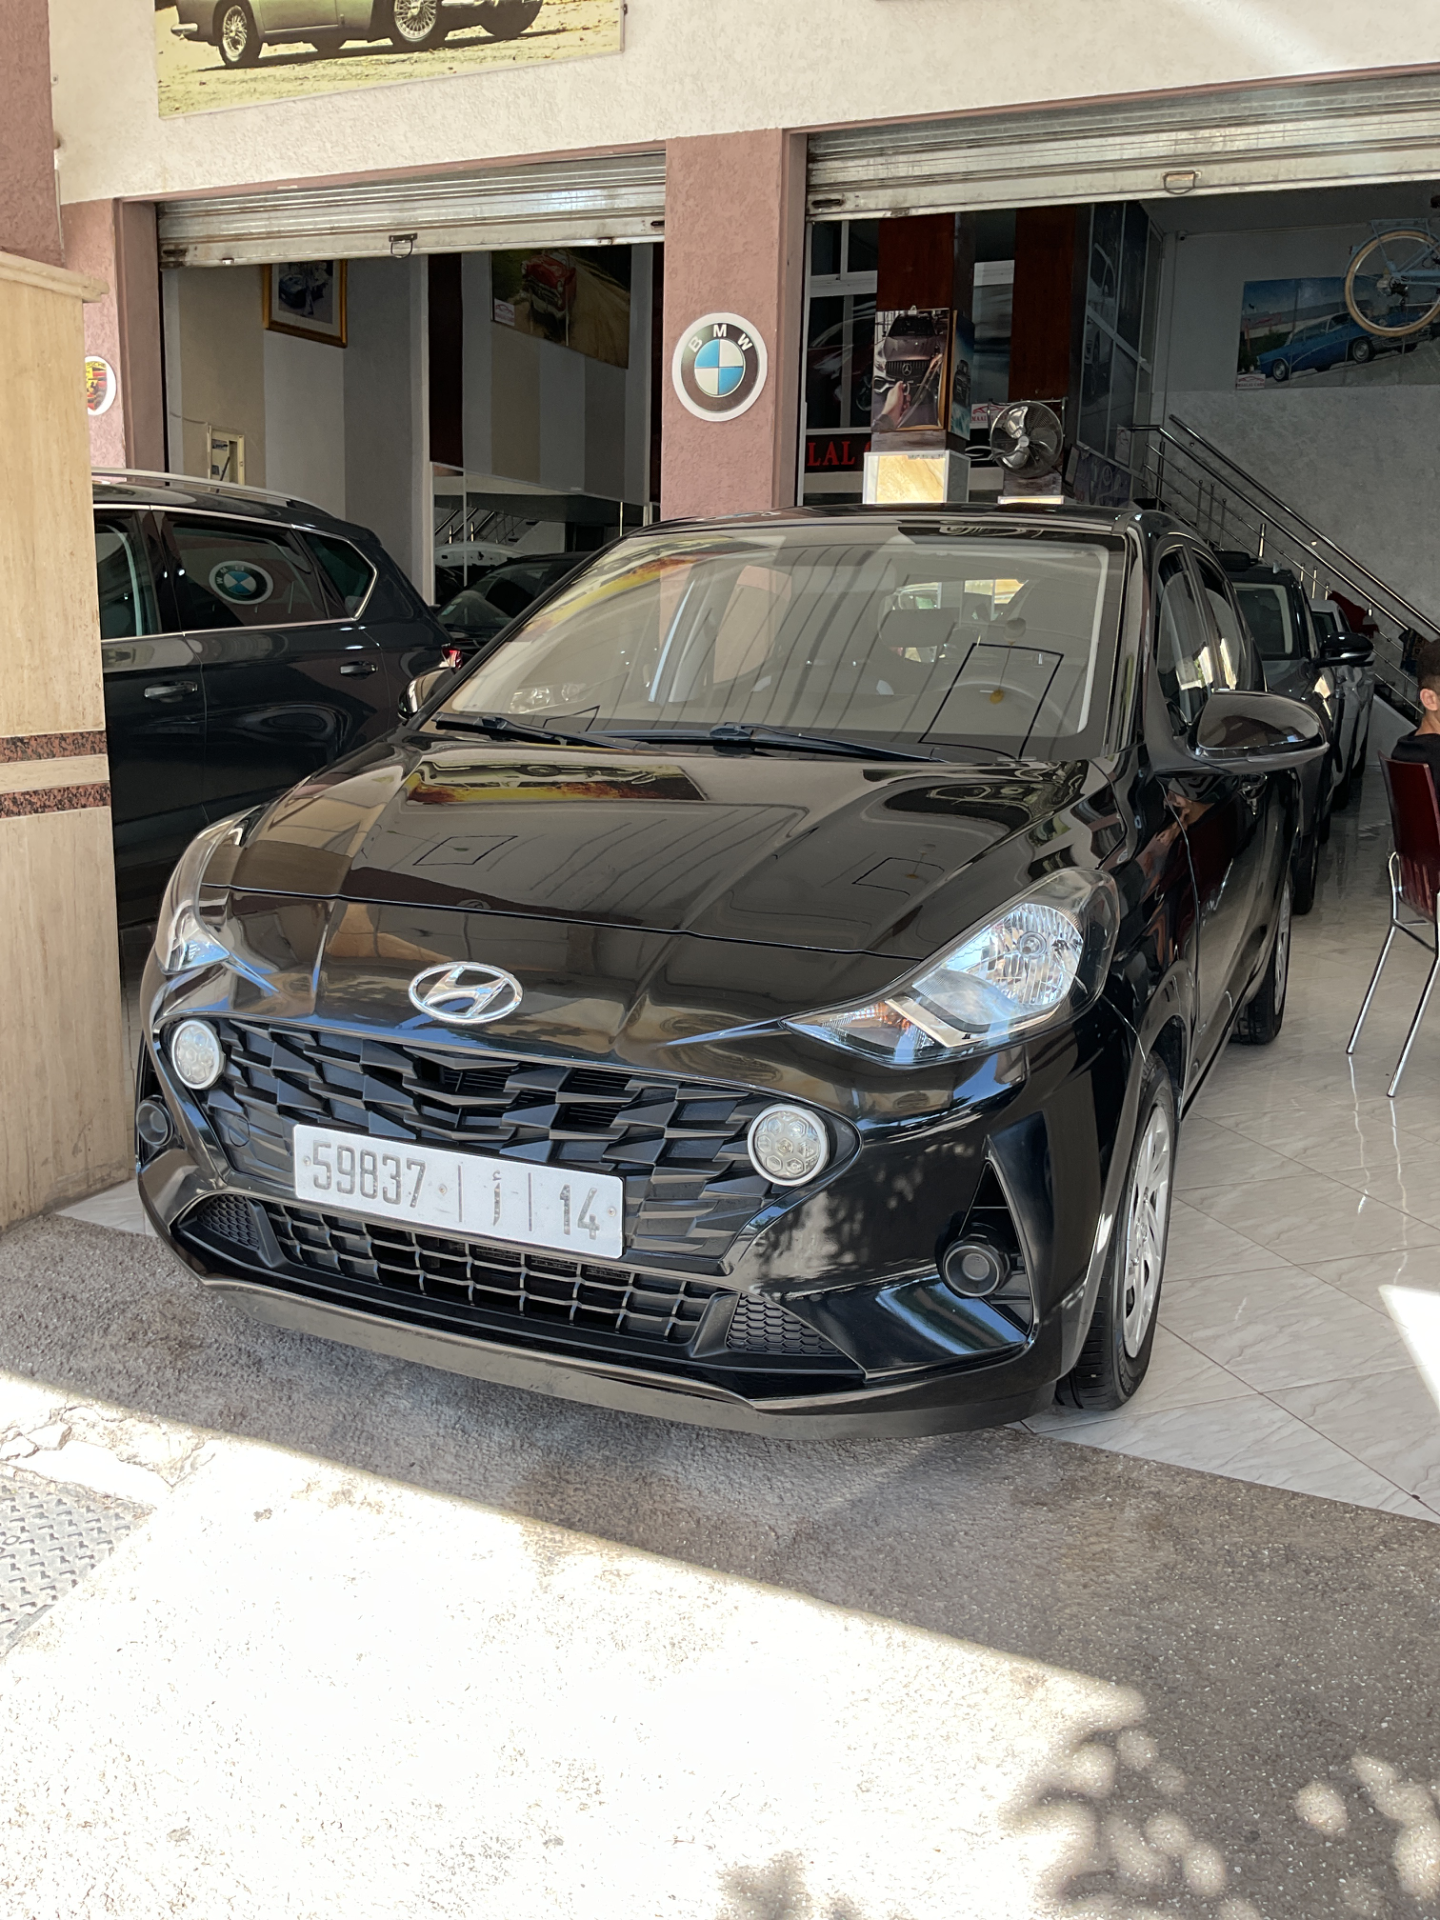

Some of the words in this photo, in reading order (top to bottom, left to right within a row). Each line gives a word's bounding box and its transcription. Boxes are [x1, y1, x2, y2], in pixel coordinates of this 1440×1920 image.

[688, 323, 753, 353] BMW
[312, 1140, 426, 1208] 59837
[559, 1184, 600, 1240] 14
